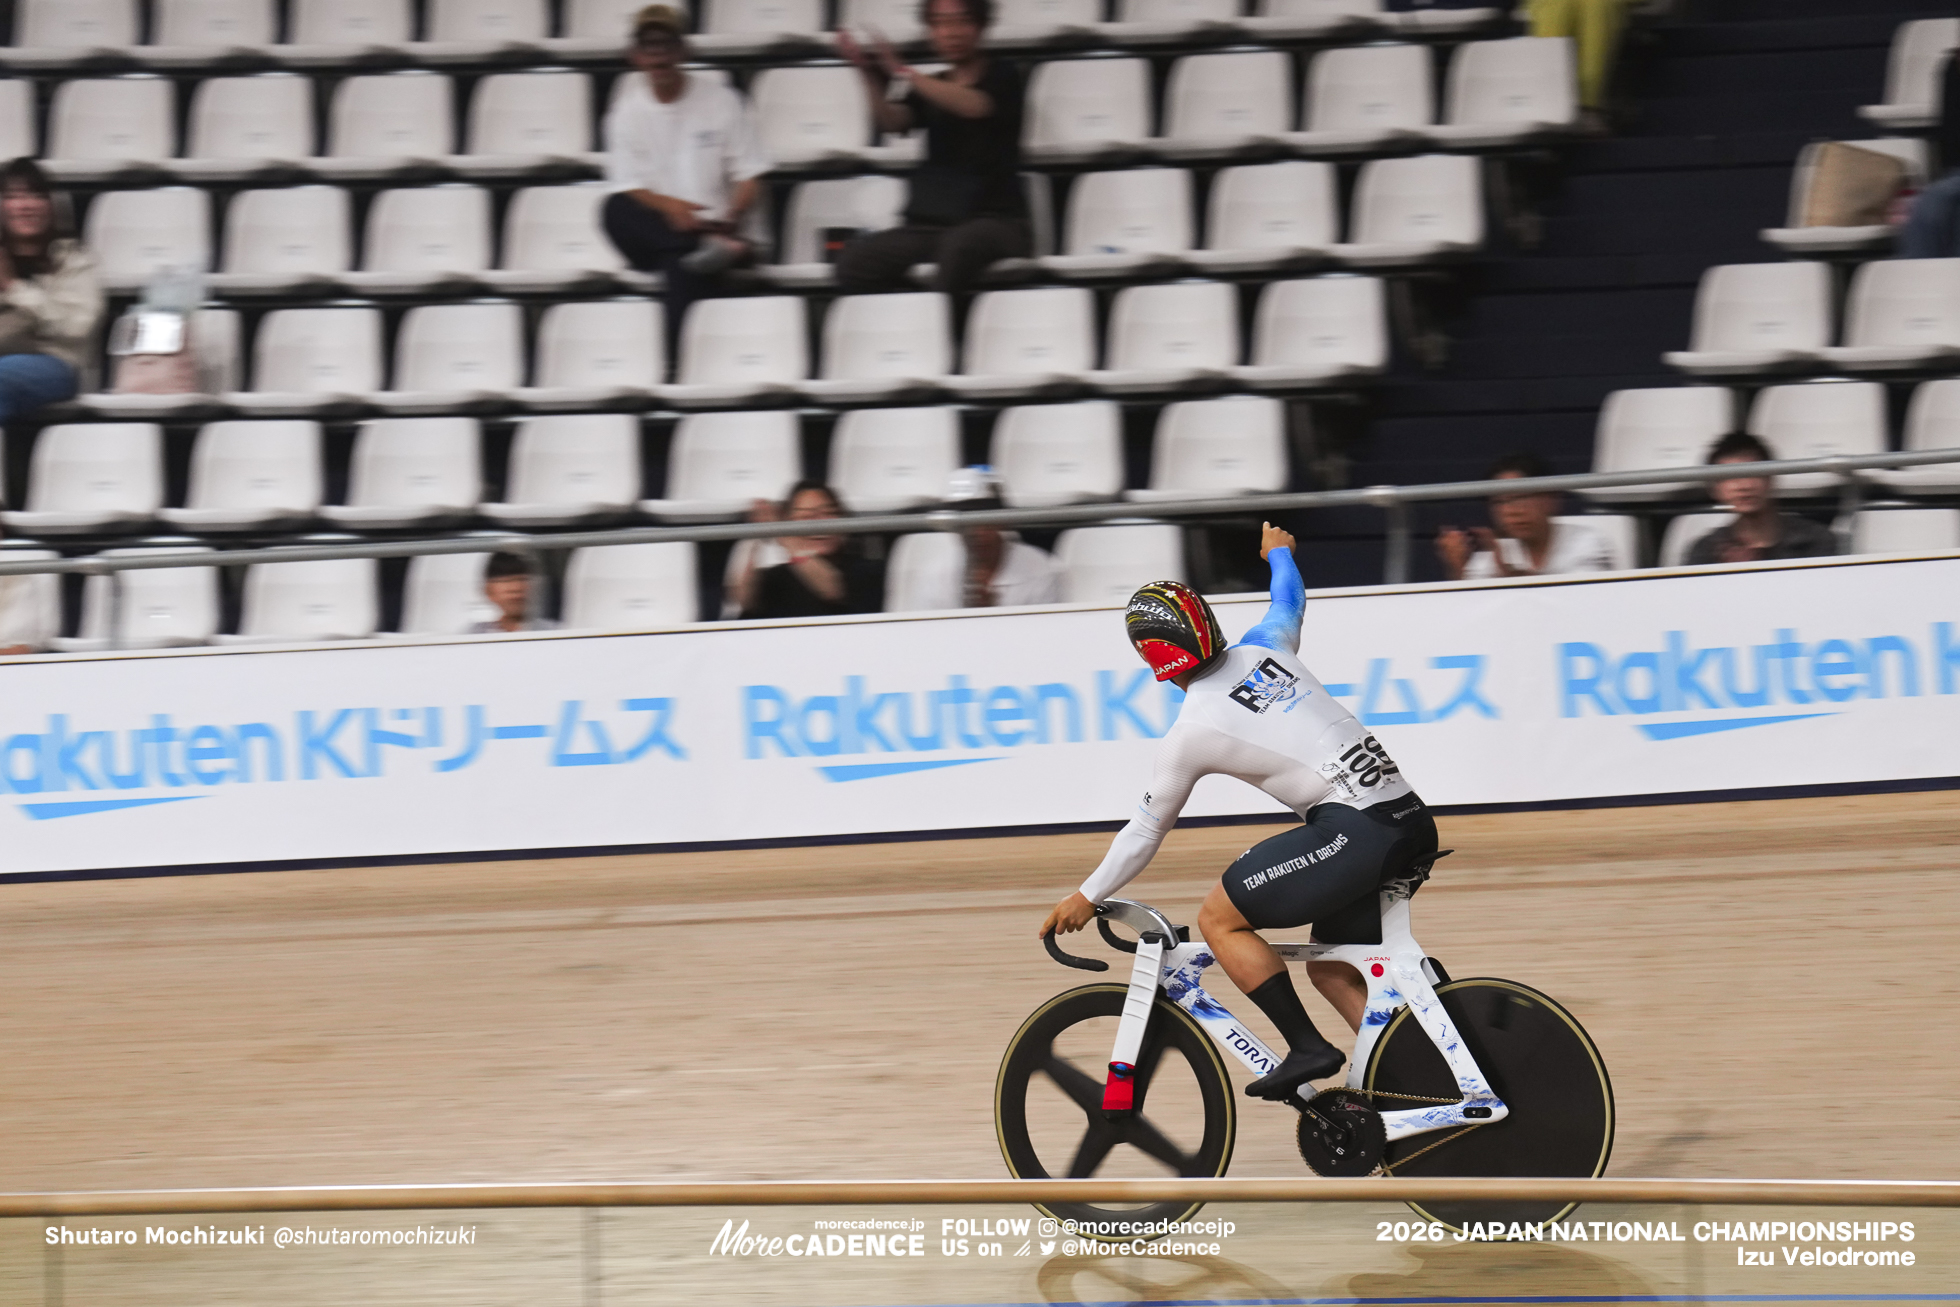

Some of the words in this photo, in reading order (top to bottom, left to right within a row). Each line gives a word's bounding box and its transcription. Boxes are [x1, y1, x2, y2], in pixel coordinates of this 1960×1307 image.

[1155, 655, 1188, 675] JAPAN
[1553, 627, 1922, 719] Rakuten
[739, 674, 1085, 760] Rakuten
[1258, 702, 1271, 714] TEAM
[0, 713, 286, 795] akuten
[293, 697, 689, 779] Kドリームス
[1339, 743, 1381, 787] 100
[1243, 871, 1268, 891] TEAM
[1266, 856, 1309, 880] RAKUTEN
[1307, 852, 1318, 864] K
[1315, 833, 1348, 861] DREAMS
[1225, 1028, 1275, 1075] TORAY
